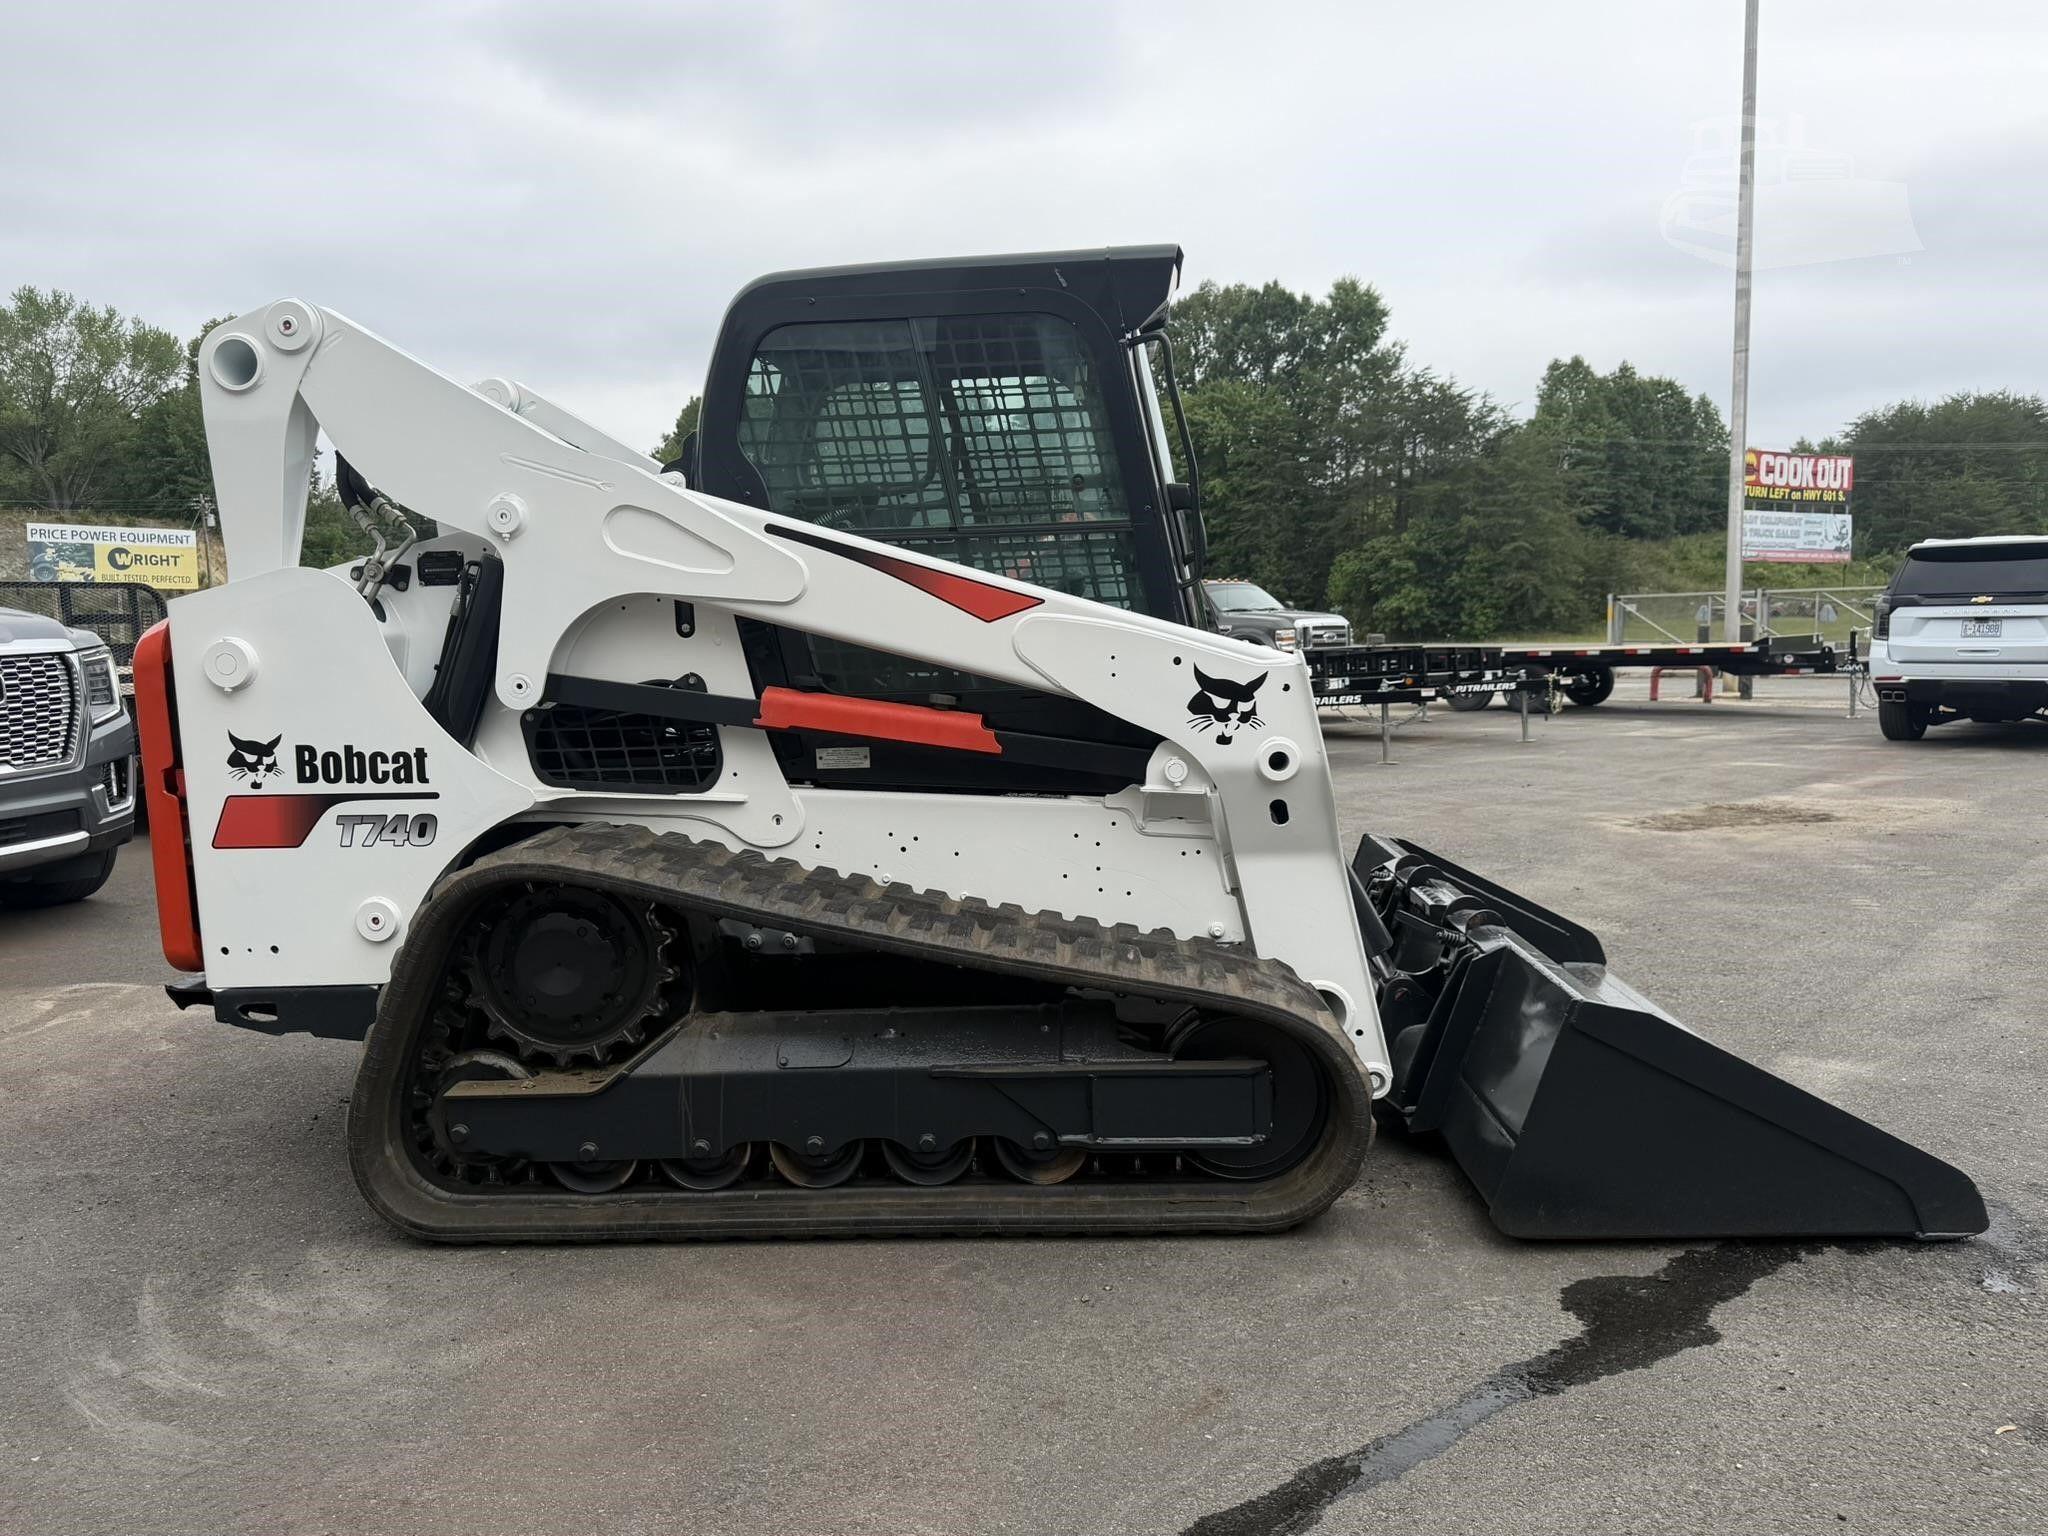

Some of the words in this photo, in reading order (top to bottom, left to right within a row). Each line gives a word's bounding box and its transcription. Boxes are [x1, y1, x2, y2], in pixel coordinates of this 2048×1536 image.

[1759, 454, 1815, 488] COOK
[1816, 458, 1851, 489] OUT
[1744, 486, 1768, 498] TURN
[1769, 487, 1790, 500] LEFT
[1791, 491, 1802, 501] on
[1803, 490, 1822, 501] HWY
[1823, 490, 1837, 502] 601
[1838, 491, 1846, 502] S.
[30, 528, 68, 540] PRICE
[71, 529, 117, 542] POWER
[120, 532, 191, 545] EQUIPMENT
[113, 551, 180, 567] WRIGHT
[151, 575, 193, 584] PERFECTED.
[1313, 694, 1362, 706] RAILERS
[295, 744, 430, 785] Bobcat
[335, 813, 438, 848] T740
